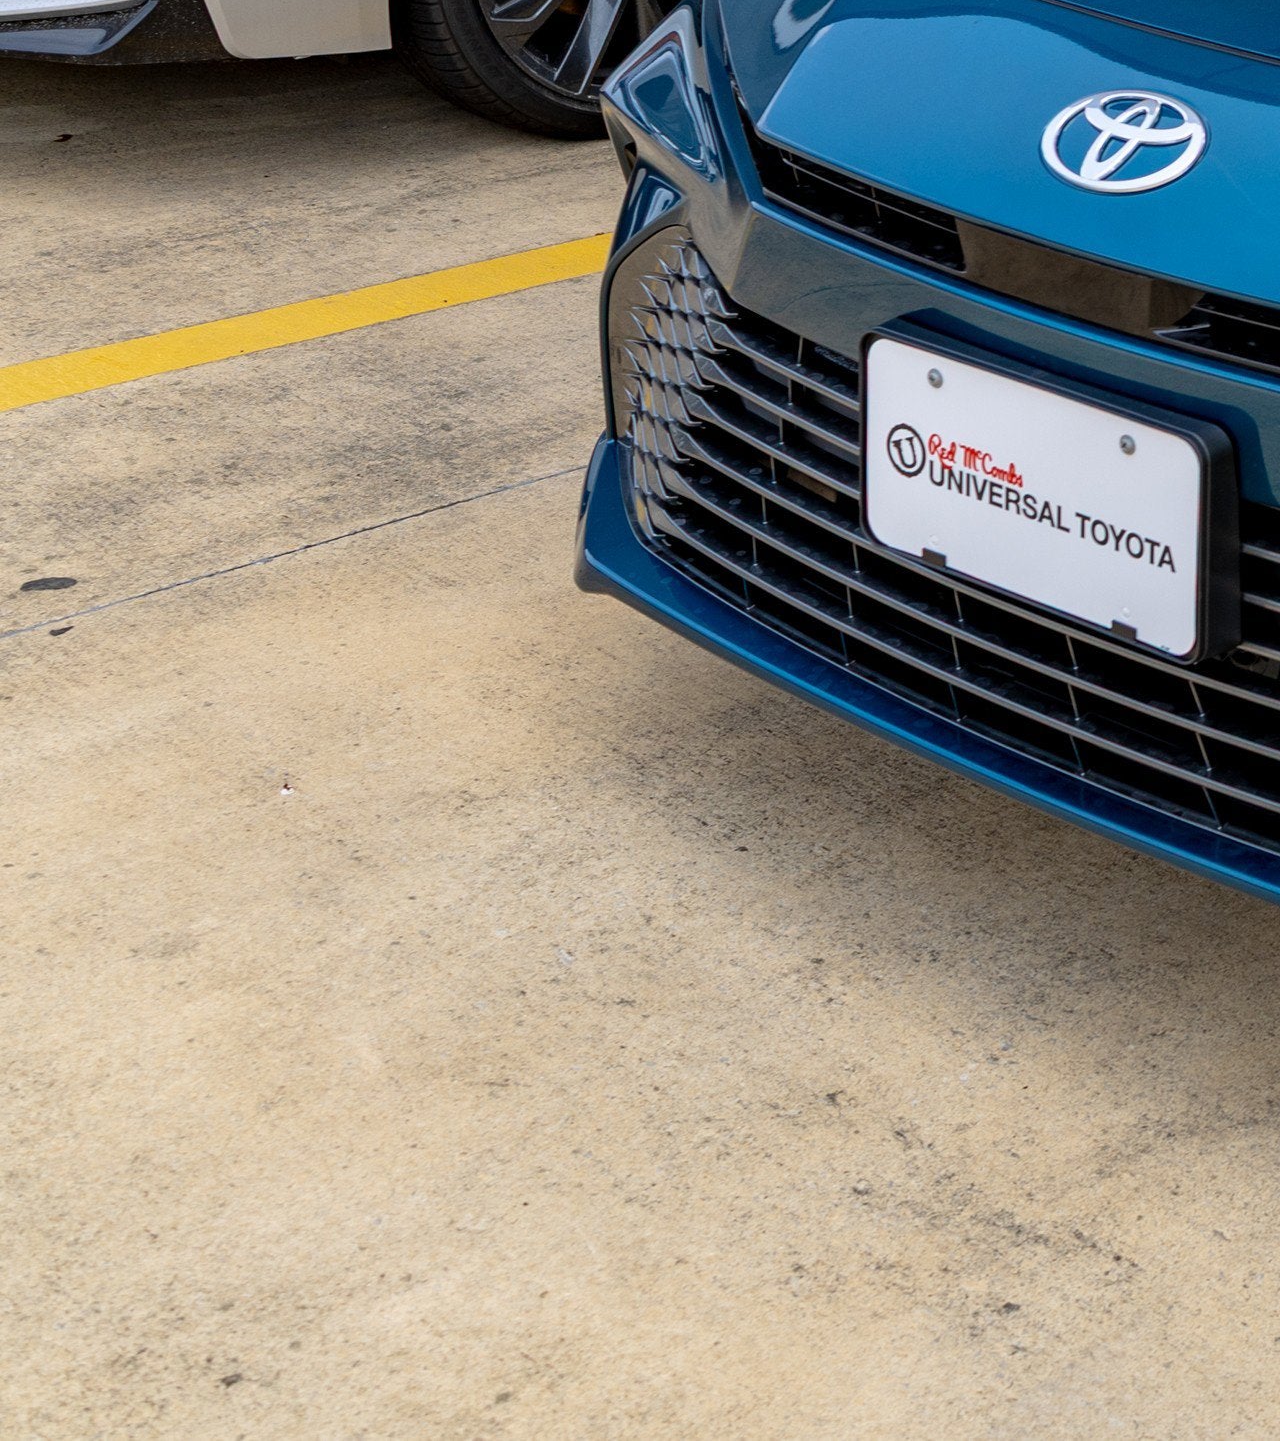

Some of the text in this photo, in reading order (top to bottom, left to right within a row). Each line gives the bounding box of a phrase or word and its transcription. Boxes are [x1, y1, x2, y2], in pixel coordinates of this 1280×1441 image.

[927, 433, 957, 470] Red
[928, 459, 1177, 574] UNIVERSAL TOYOTA
